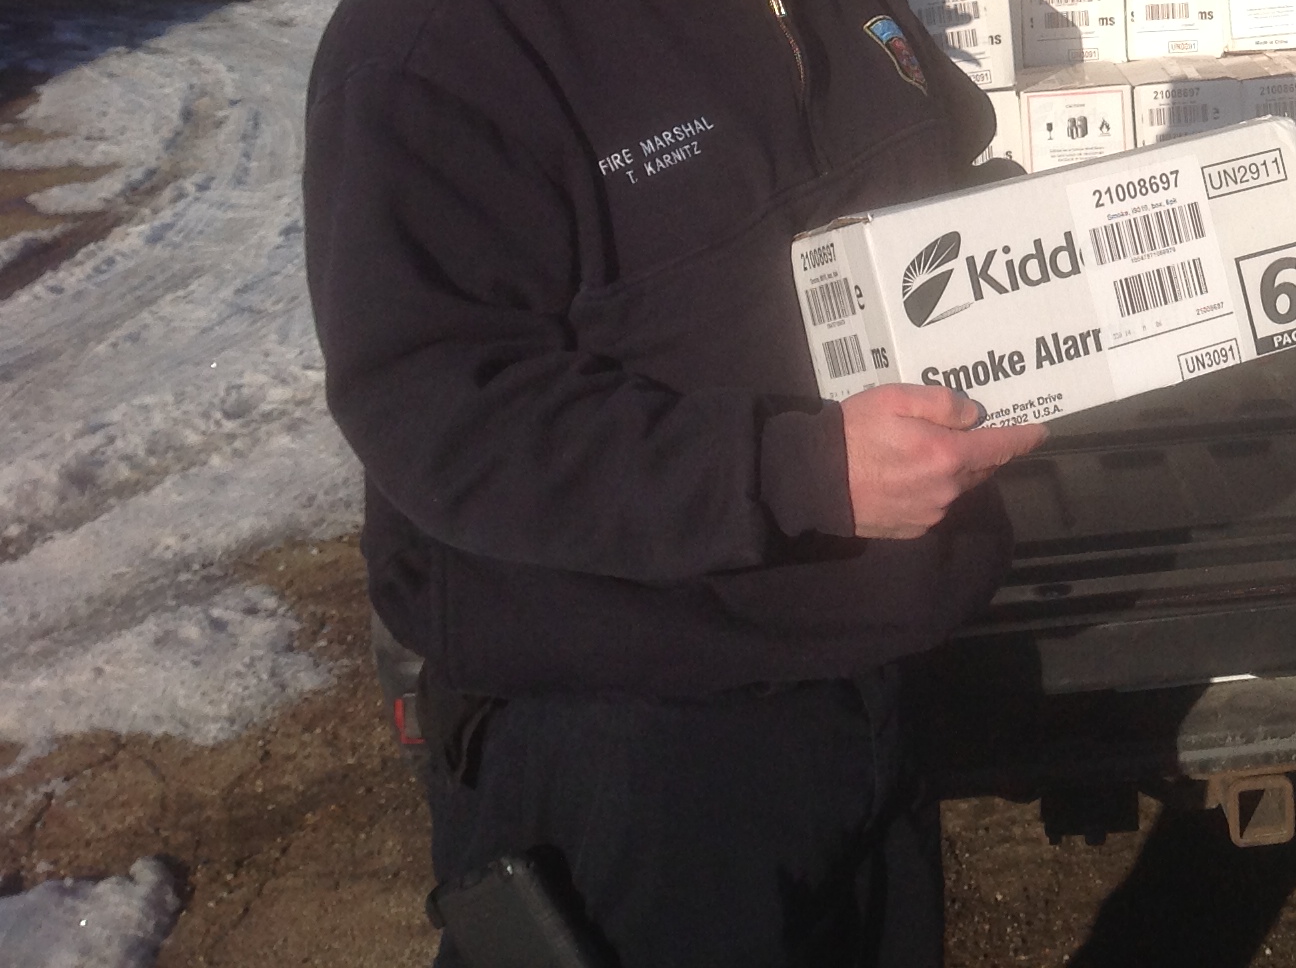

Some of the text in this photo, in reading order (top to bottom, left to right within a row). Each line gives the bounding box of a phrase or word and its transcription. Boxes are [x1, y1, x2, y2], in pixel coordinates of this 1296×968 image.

[1153, 88, 1200, 100] 21008697
[598, 116, 714, 176] FIRE MARSHAL
[643, 141, 702, 177] KARNITZ
[1092, 169, 1180, 209] 21008697
[1207, 157, 1282, 191] UN2911
[800, 242, 837, 271] 21008697
[965, 230, 1085, 302] Kidd
[921, 350, 1026, 392] Smoke
[1185, 345, 1236, 374] UN3091
[999, 413, 1029, 429] 27302
[1033, 404, 1064, 420] U.S.A.
[1012, 399, 1036, 415] Park
[1037, 393, 1063, 407] Drive
